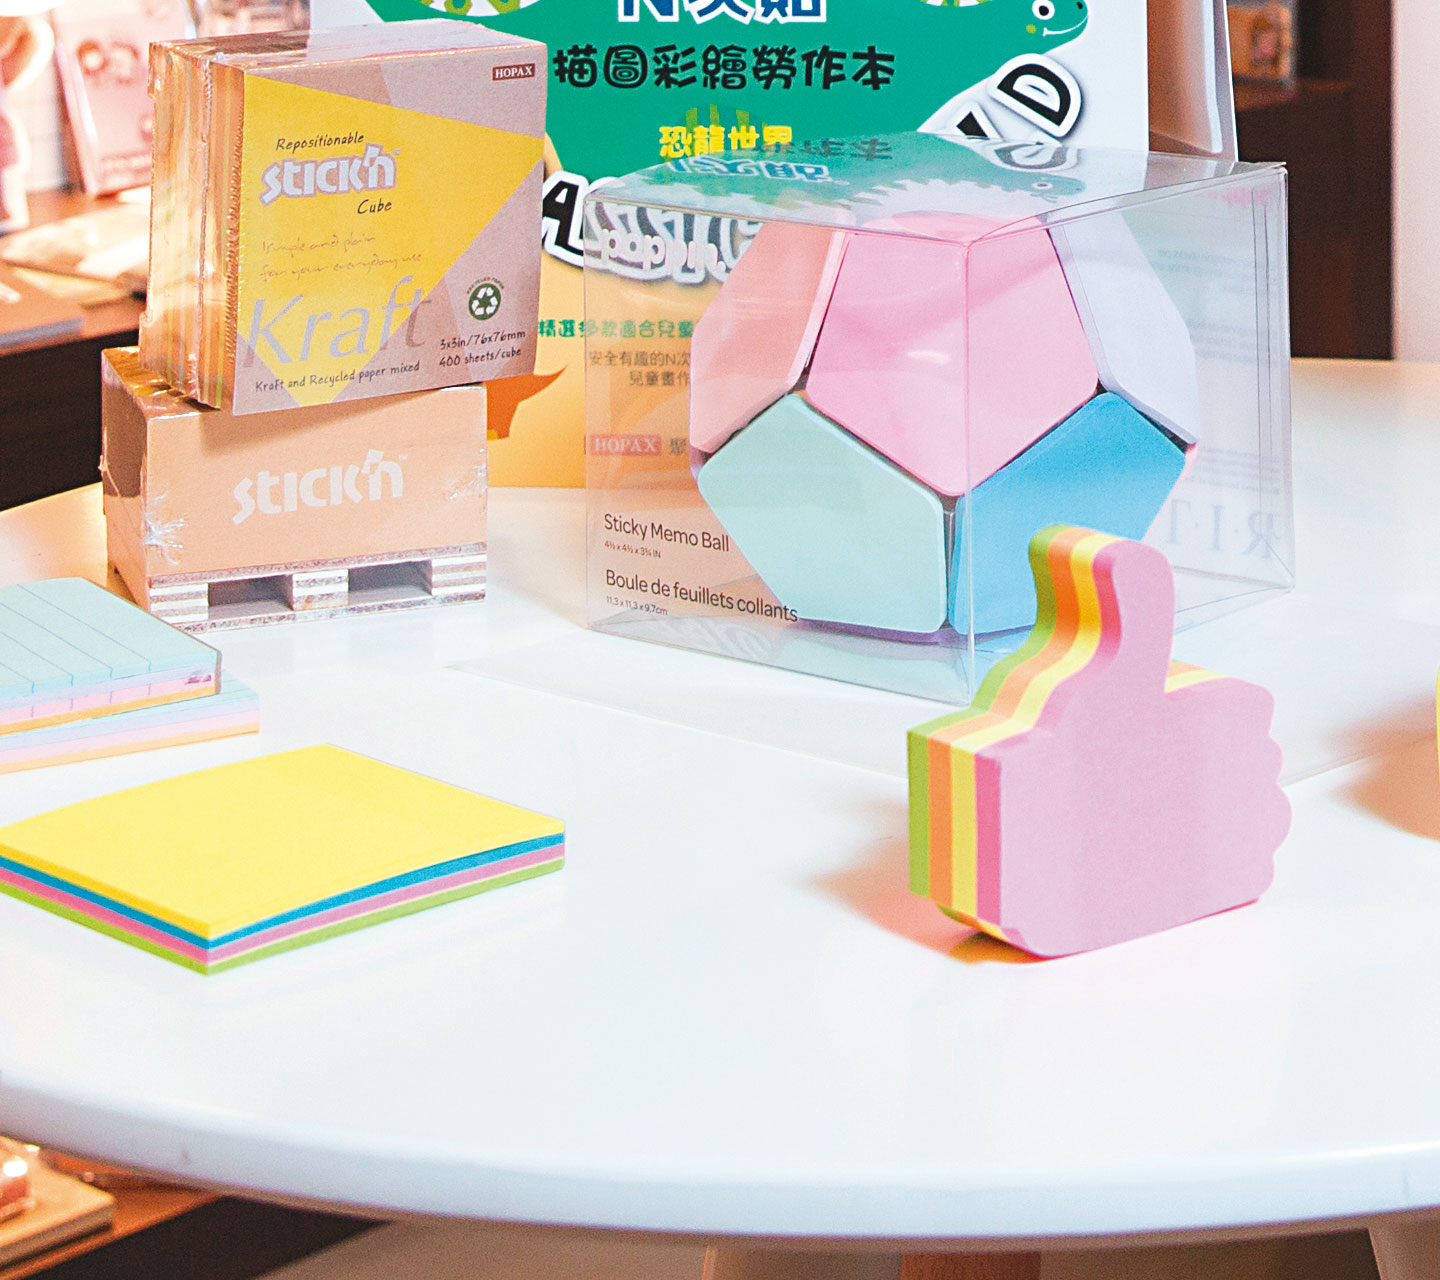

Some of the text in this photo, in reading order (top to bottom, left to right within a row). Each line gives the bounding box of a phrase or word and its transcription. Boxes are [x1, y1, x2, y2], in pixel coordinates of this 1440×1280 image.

[494, 65, 534, 80] HOPAX
[552, 43, 896, 91] 描圖彩繪勞作本
[275, 130, 365, 154] Repositionable
[658, 123, 793, 159] 恐龍世界
[356, 197, 393, 215] Cube
[243, 274, 432, 369] Kraft
[438, 346, 523, 368] 400 sheets/cube
[255, 360, 421, 393] Kraft and Recycled paper mixed
[603, 513, 730, 552] Sticky Memo Ball
[606, 569, 799, 623] Boule de feuillets collants
